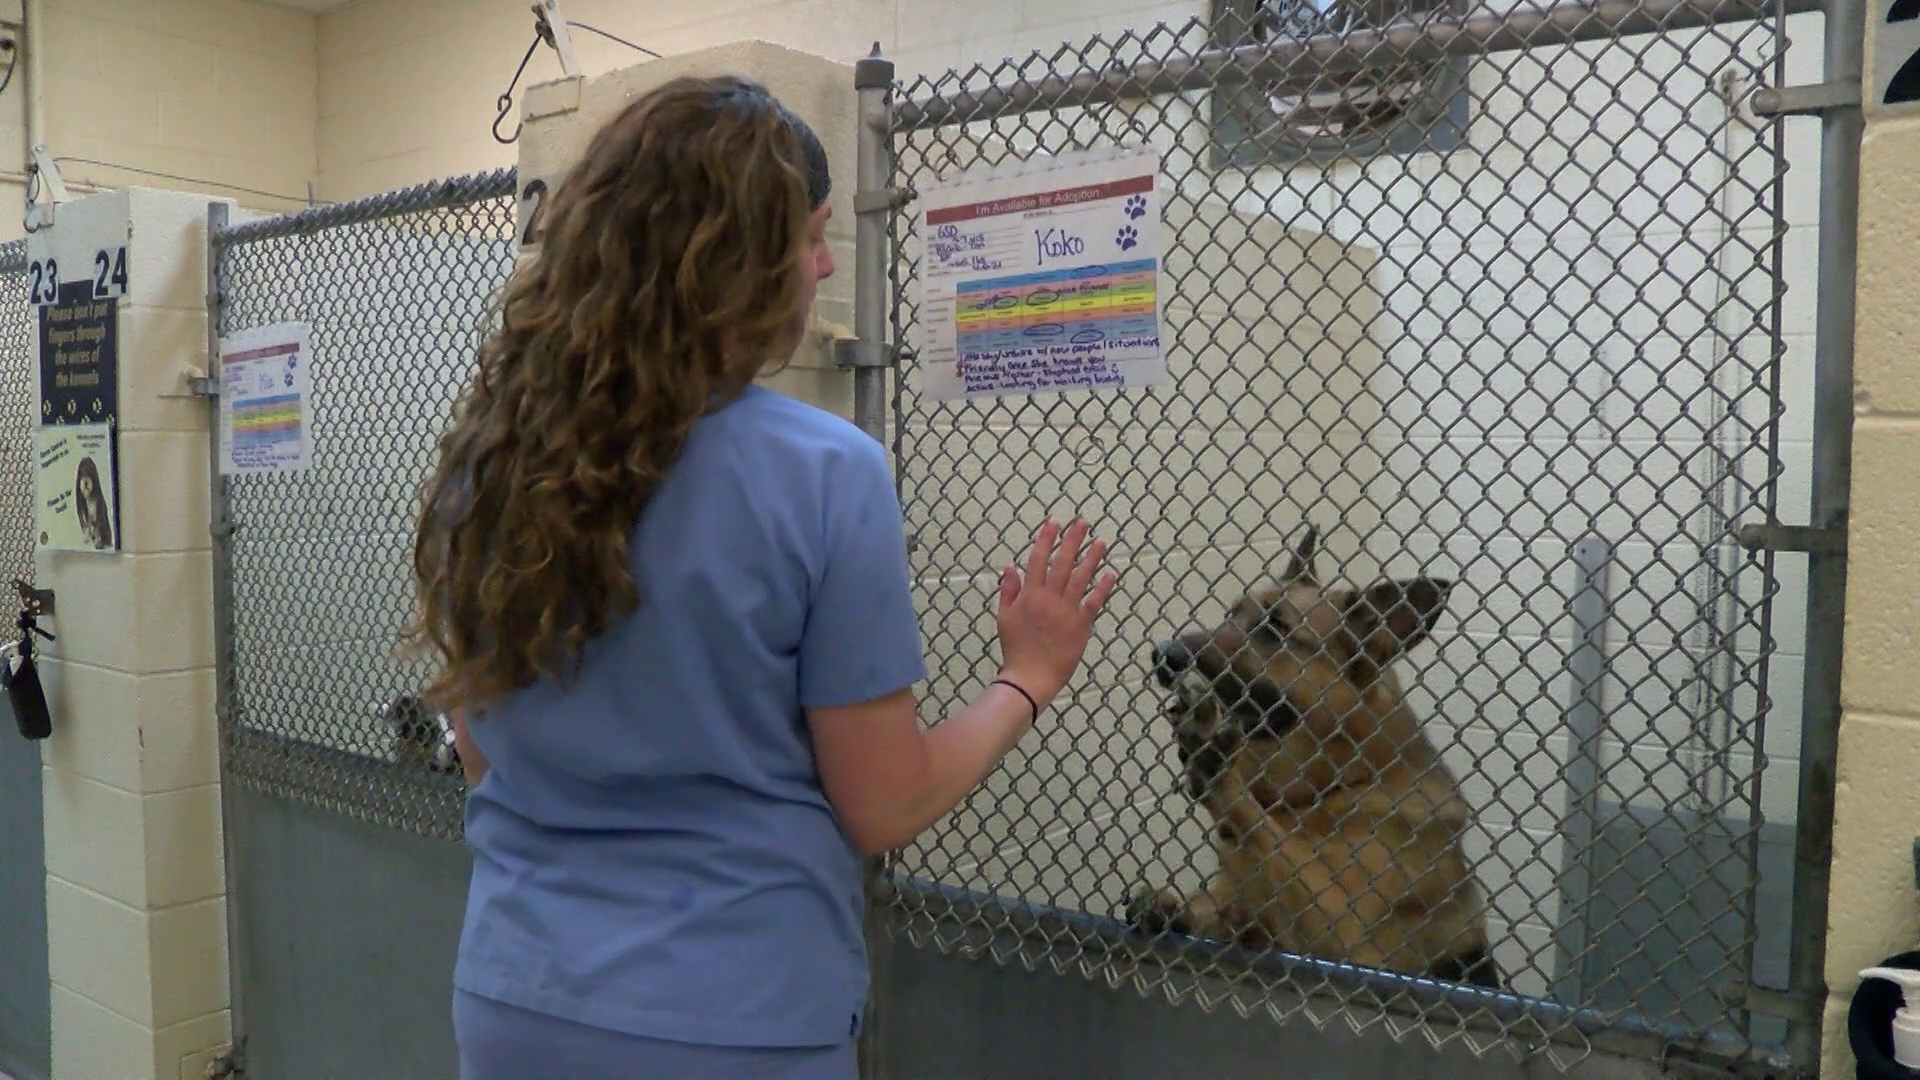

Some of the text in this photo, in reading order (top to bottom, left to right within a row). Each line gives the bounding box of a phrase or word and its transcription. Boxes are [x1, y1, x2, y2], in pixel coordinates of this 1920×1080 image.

[975, 204, 990, 216] I'm
[992, 198, 1037, 214] Available
[1039, 195, 1054, 208] for
[1054, 188, 1100, 205] Adoption
[1034, 228, 1085, 265] Koko
[30, 257, 57, 304] 23
[95, 247, 128, 296] 24
